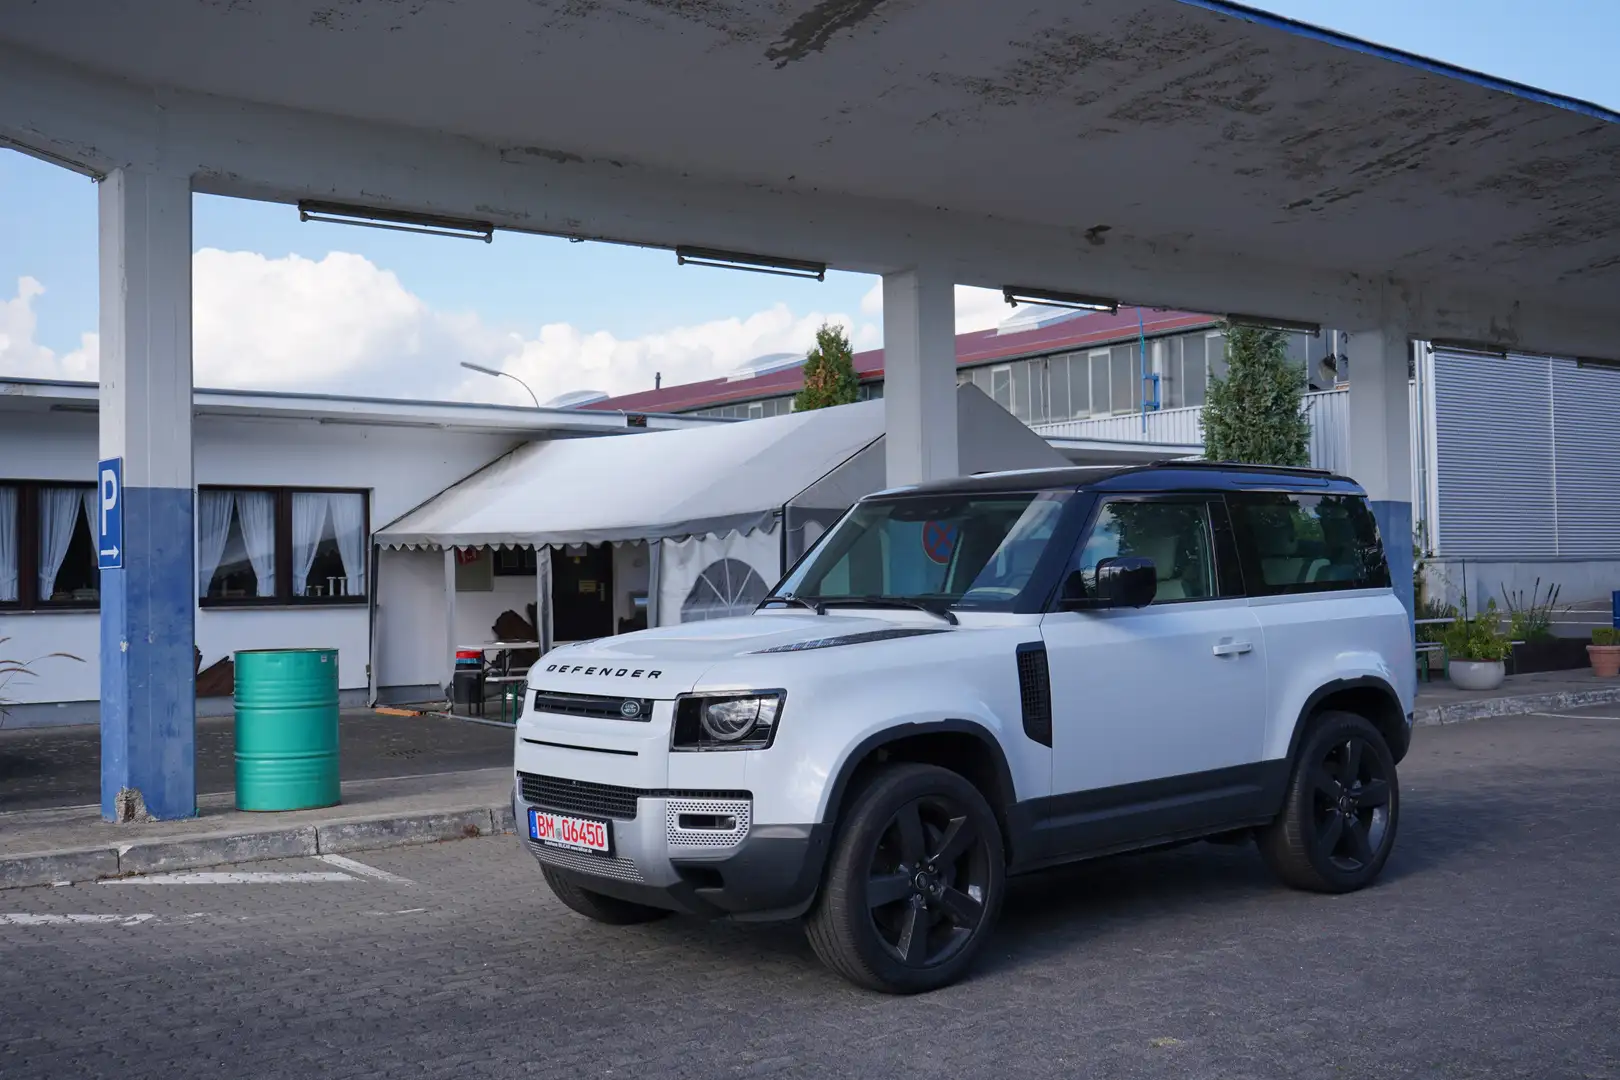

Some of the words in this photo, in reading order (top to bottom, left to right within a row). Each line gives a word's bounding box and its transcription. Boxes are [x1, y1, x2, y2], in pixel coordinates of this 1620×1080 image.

[102, 469, 117, 535] P
[546, 664, 662, 679] DEFENDER
[537, 815, 555, 839] BM
[562, 819, 604, 847] 06450
